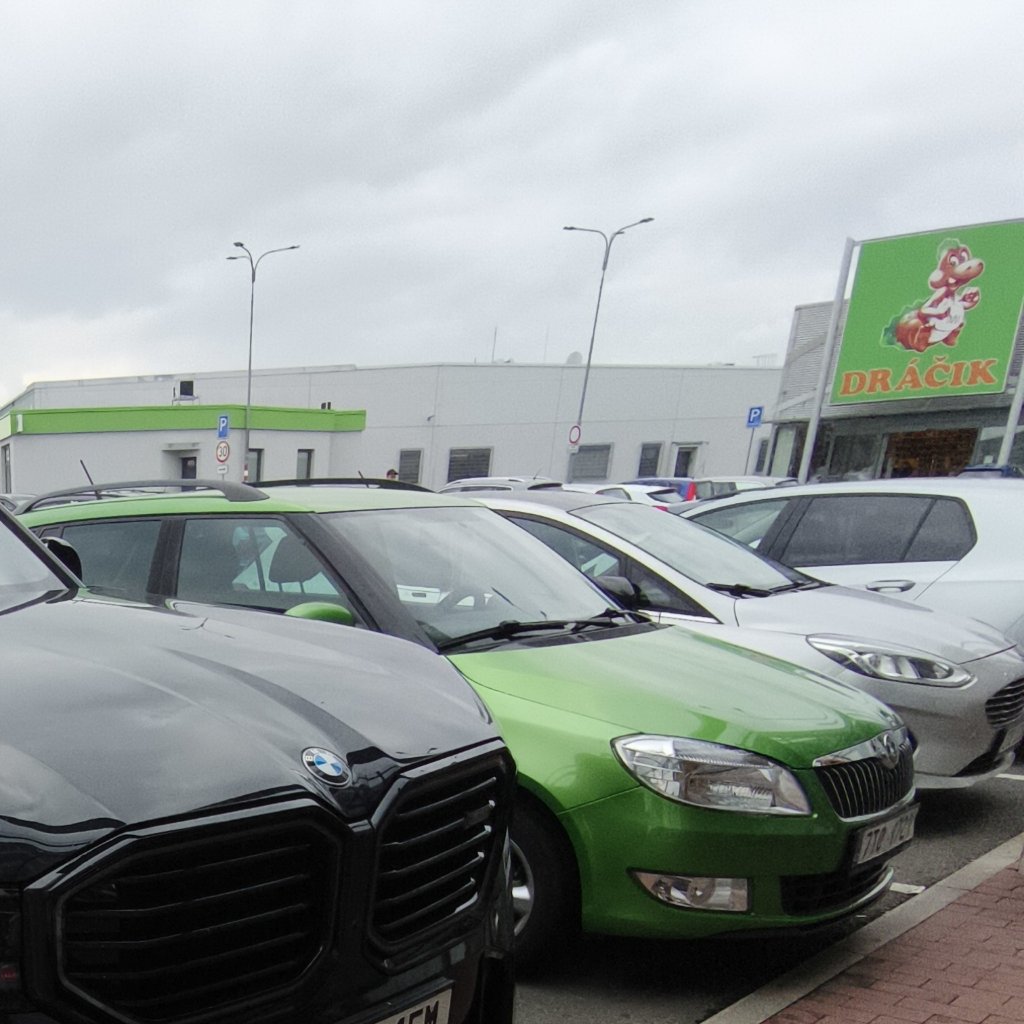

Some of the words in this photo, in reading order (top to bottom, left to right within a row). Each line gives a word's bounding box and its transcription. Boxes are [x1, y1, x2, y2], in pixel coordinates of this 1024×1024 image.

[839, 355, 999, 397] DRÁČIK
[749, 408, 761, 422] P
[219, 417, 227, 432] P
[218, 445, 227, 458] 30
